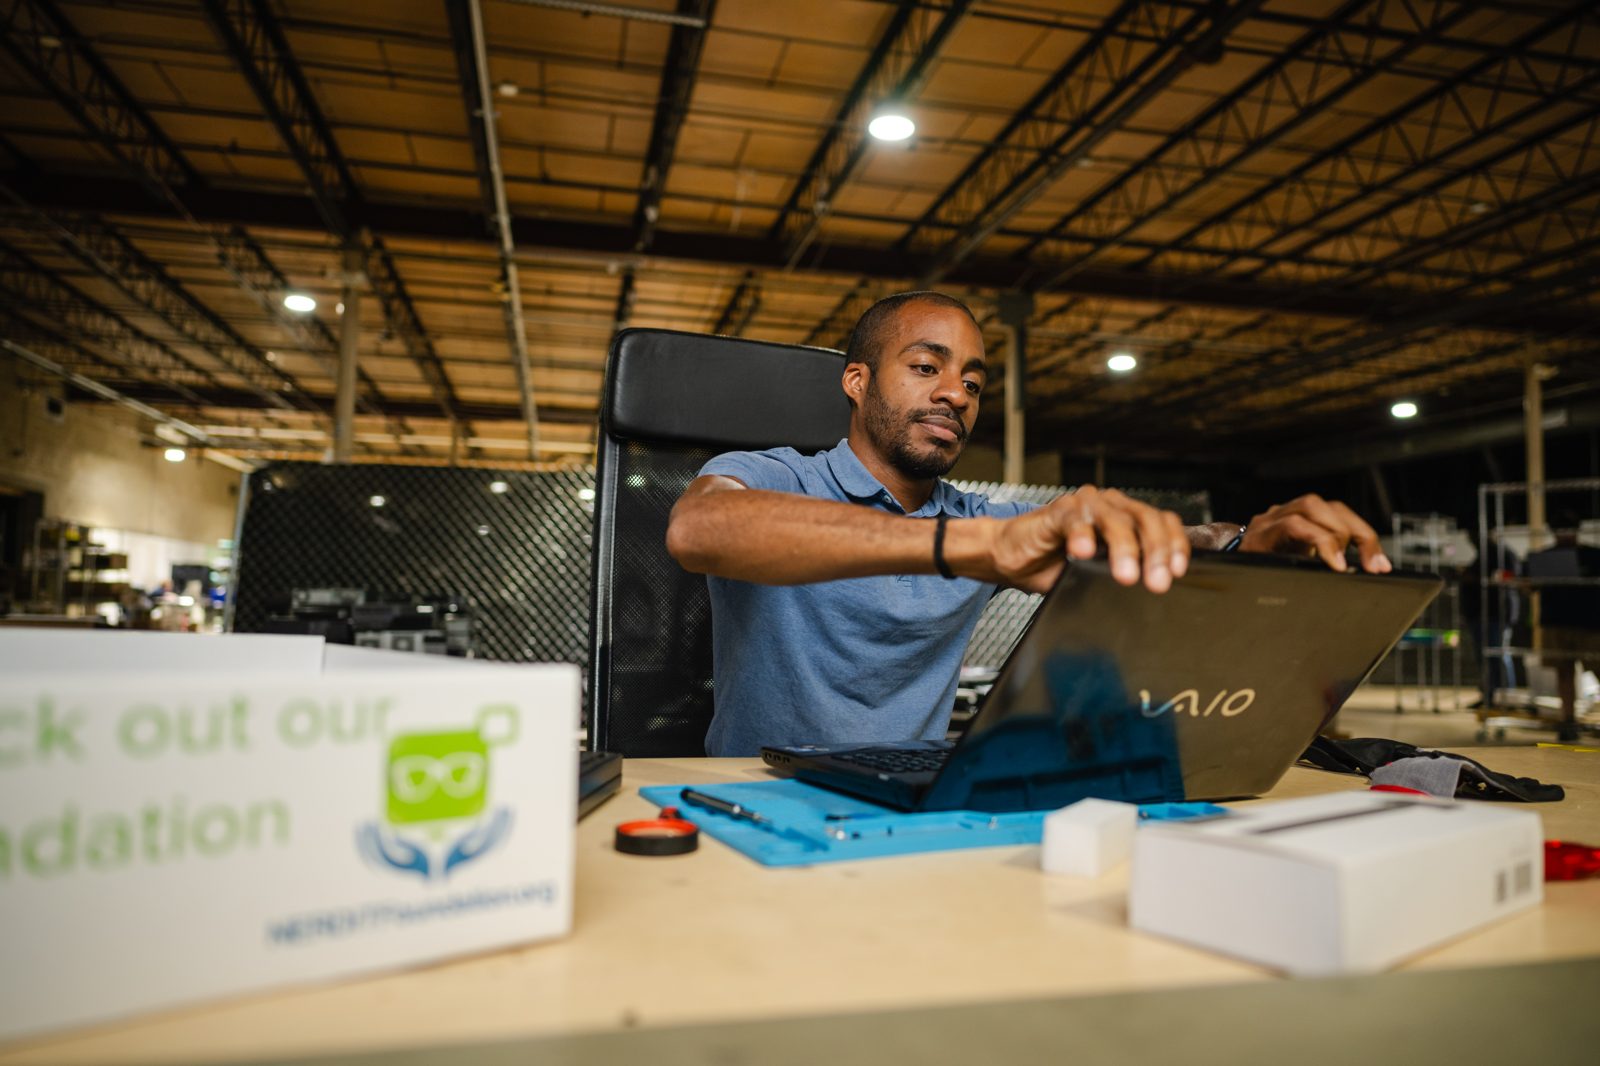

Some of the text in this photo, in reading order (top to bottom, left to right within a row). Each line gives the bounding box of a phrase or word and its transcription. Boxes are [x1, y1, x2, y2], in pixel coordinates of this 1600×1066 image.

[117, 692, 250, 760] out
[276, 697, 394, 749] our
[1139, 688, 1256, 718] VAIO
